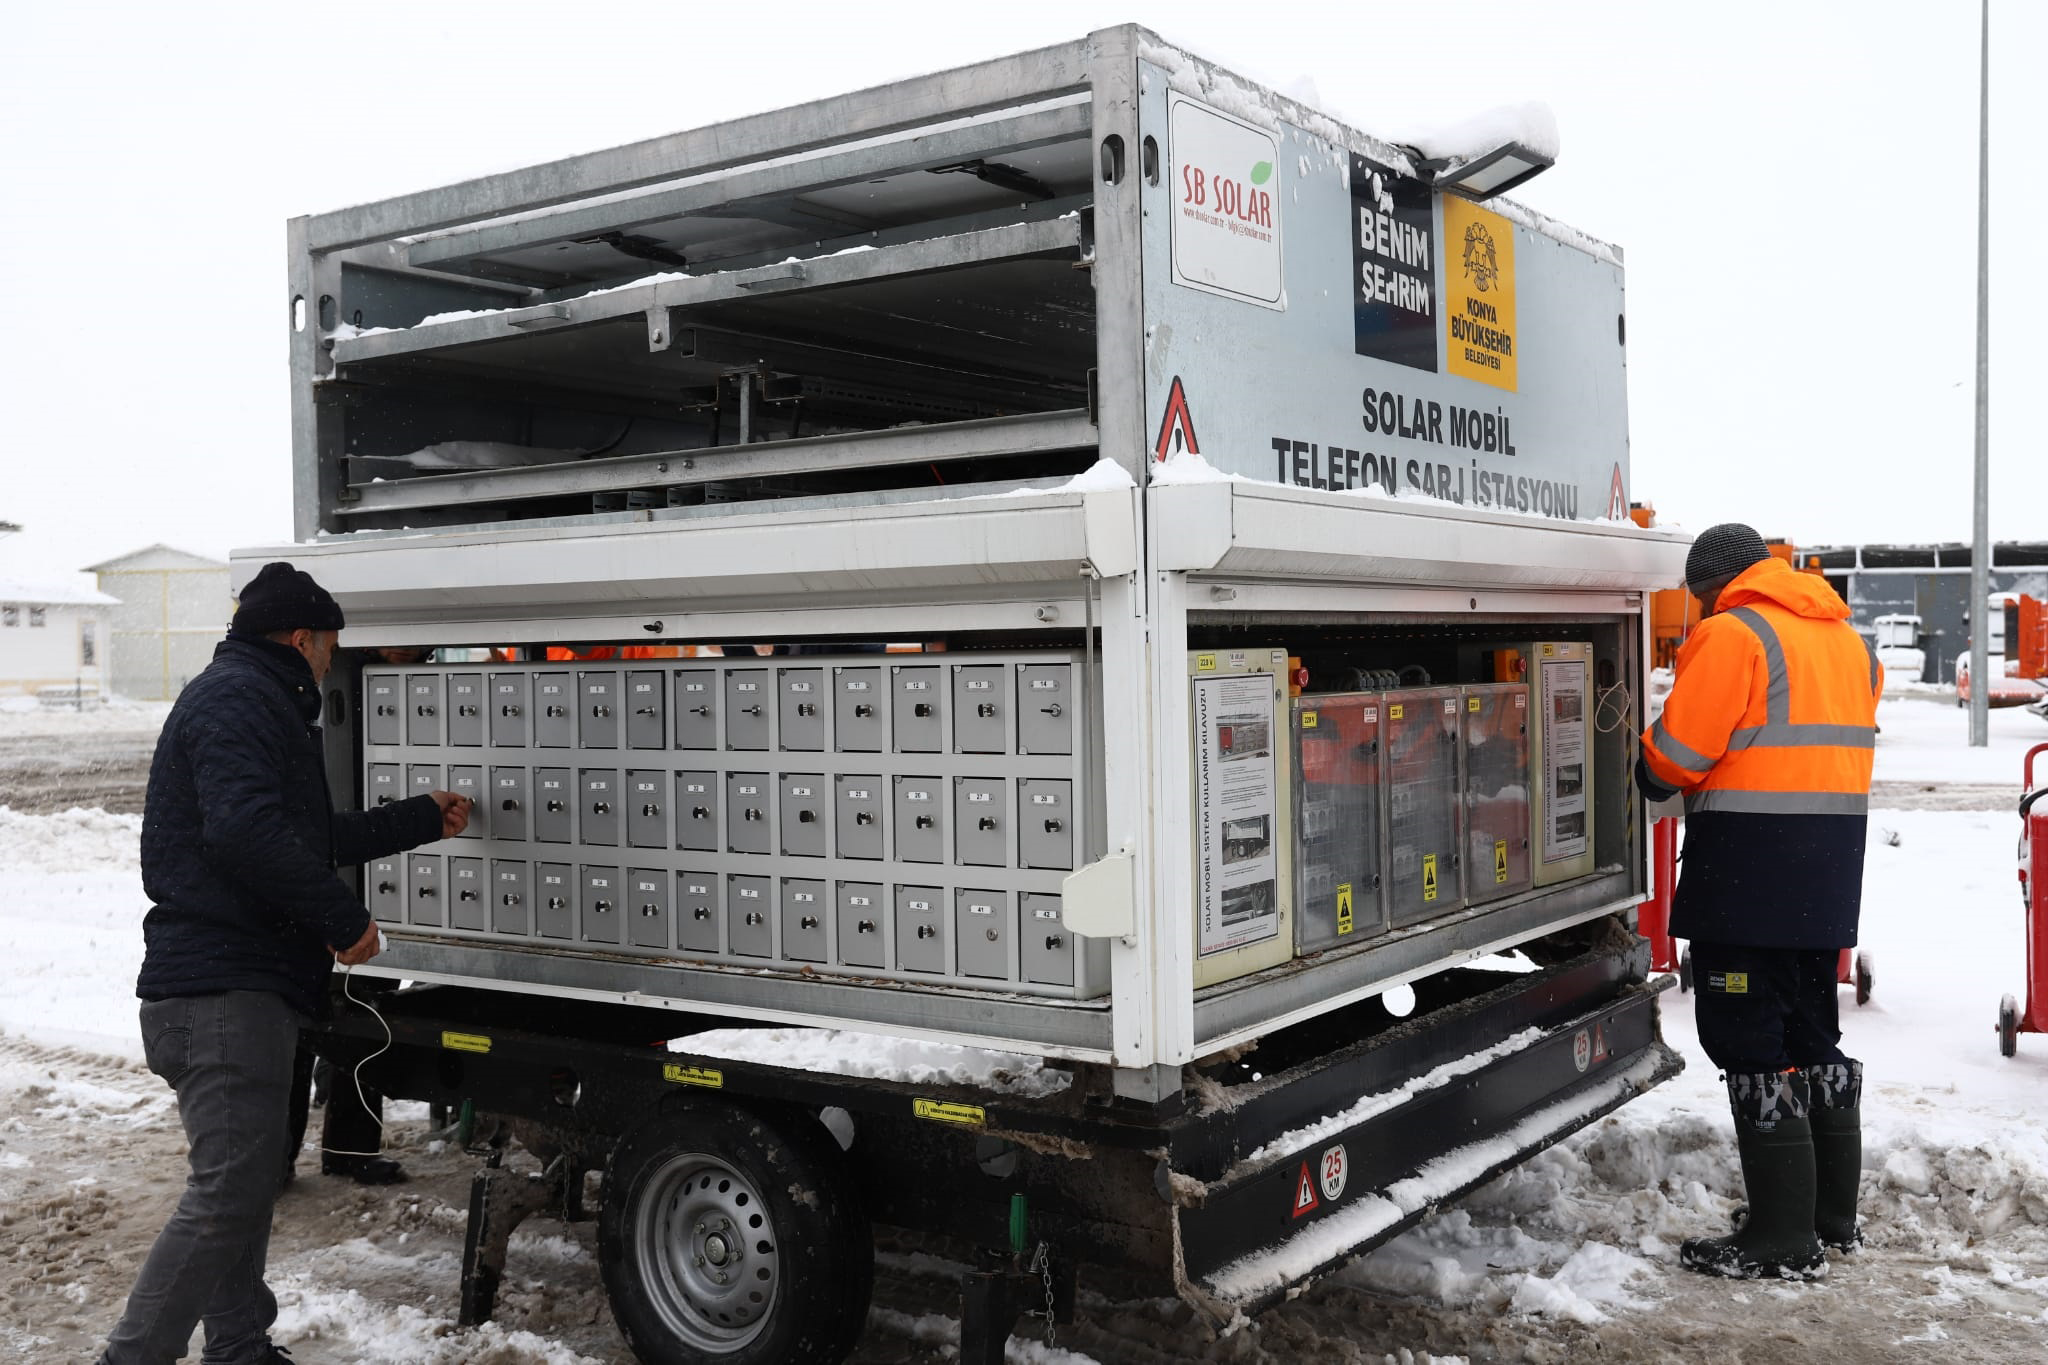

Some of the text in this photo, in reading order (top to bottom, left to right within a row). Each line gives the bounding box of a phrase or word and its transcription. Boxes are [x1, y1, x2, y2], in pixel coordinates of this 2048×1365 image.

[1183, 164, 1272, 229] SB SOLAR
[1466, 296, 1497, 325] KONYA
[1451, 313, 1512, 357] BÜYÜKŞEHİR
[1362, 387, 1516, 457] SOLAR MOBİL
[1271, 437, 1397, 497] TELEFON
[1200, 688, 1208, 745] KILAVUZU
[1577, 1033, 1587, 1056] 25
[1326, 1150, 1342, 1179] 25
[1328, 1176, 1340, 1192] KM
